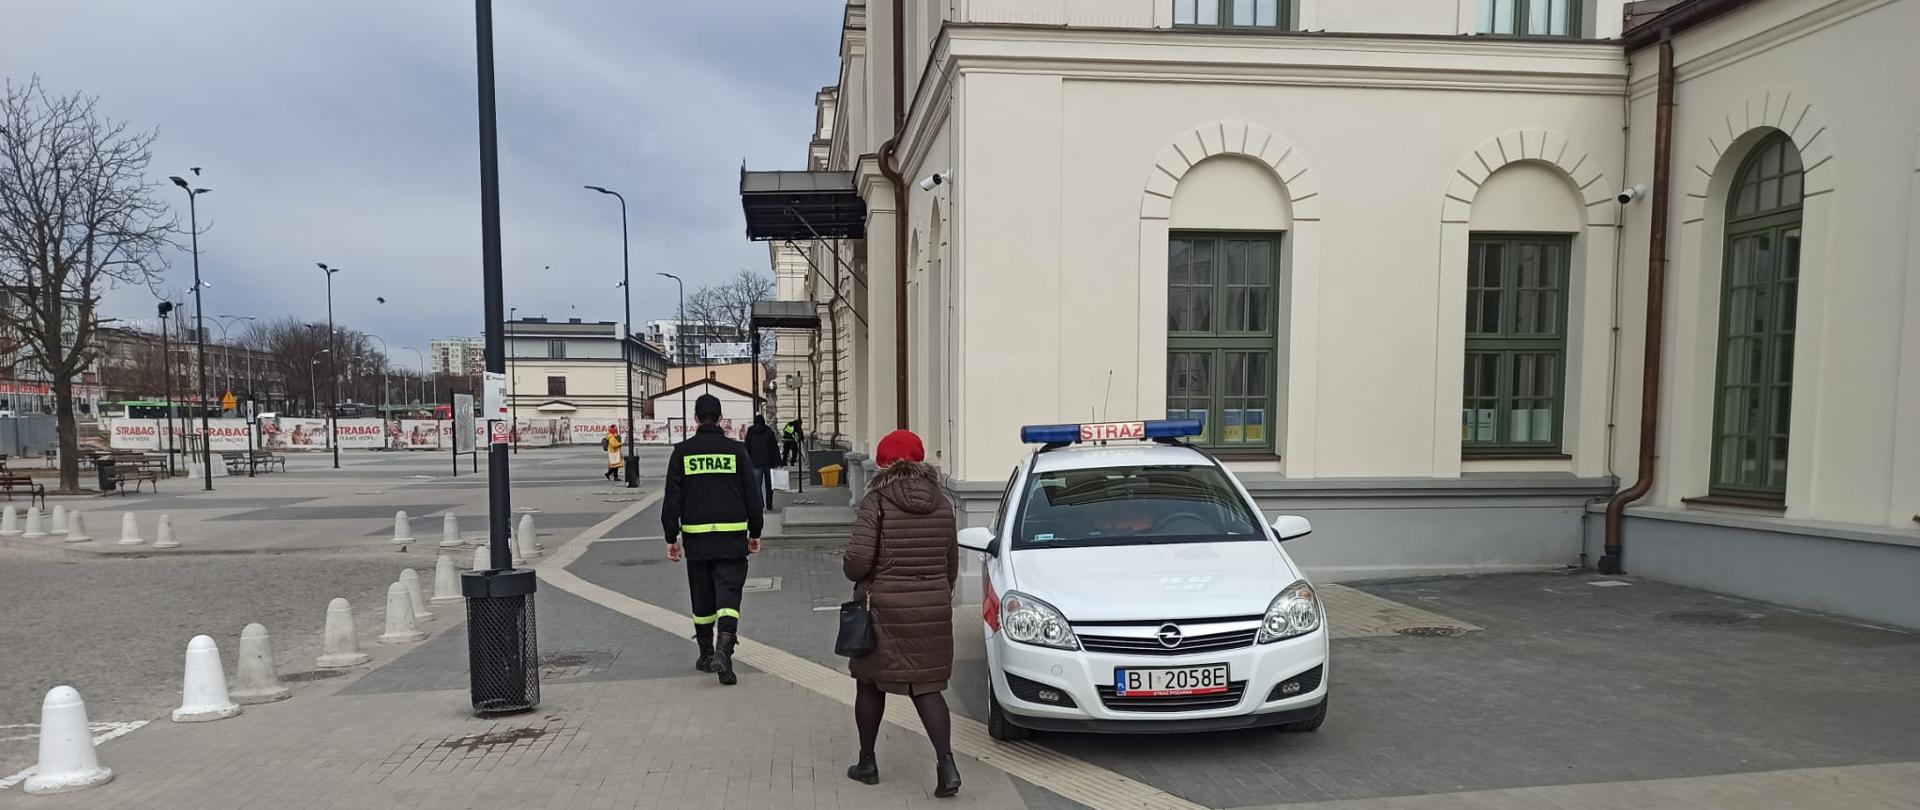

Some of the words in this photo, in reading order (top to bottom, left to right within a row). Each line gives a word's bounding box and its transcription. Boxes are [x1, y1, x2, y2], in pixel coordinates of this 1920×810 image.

[115, 426, 155, 436] STRABAG
[195, 427, 251, 436] SRABAG
[574, 424, 609, 433] STRABA
[1165, 667, 1225, 689] 2058E
